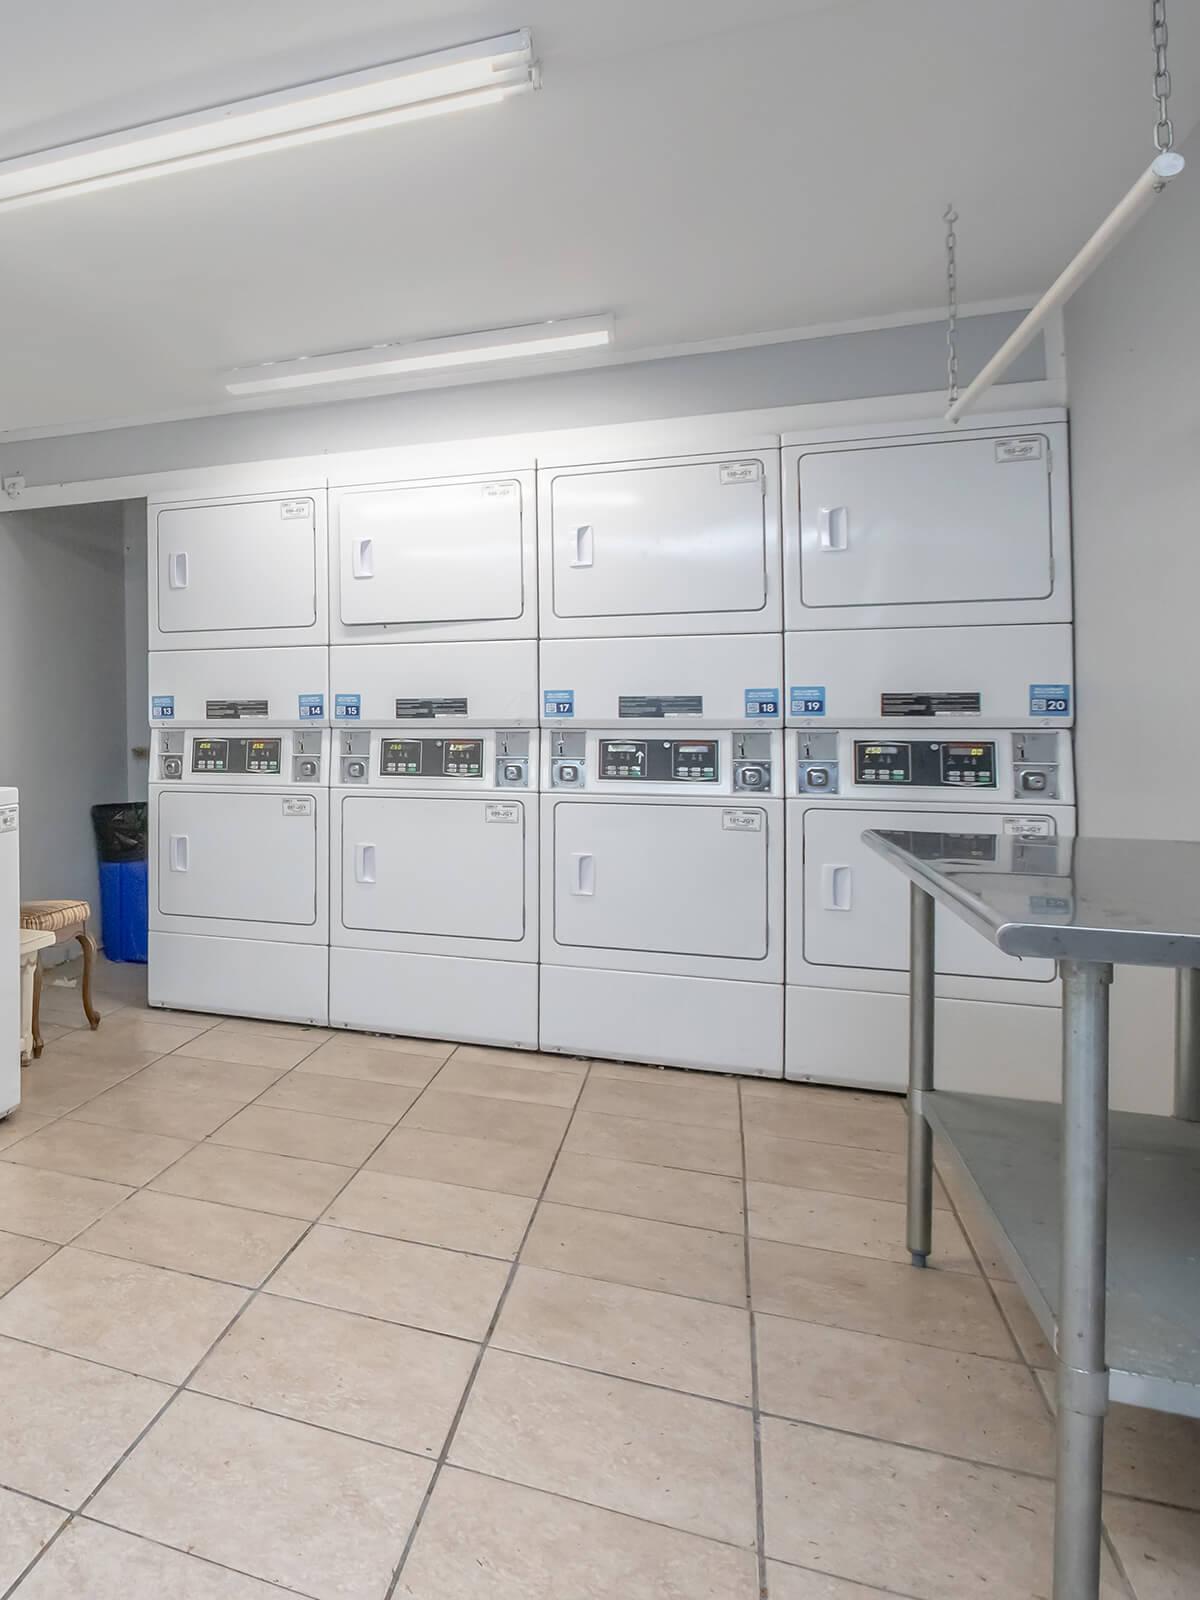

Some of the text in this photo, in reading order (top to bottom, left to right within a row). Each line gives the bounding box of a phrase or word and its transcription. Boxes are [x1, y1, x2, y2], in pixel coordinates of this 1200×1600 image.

[559, 703, 570, 712] 17
[761, 703, 775, 712] 18
[807, 702, 820, 711] 19
[1047, 700, 1066, 710] 20
[163, 707, 172, 715] 13
[311, 706, 321, 715] 14
[347, 707, 357, 715] 15
